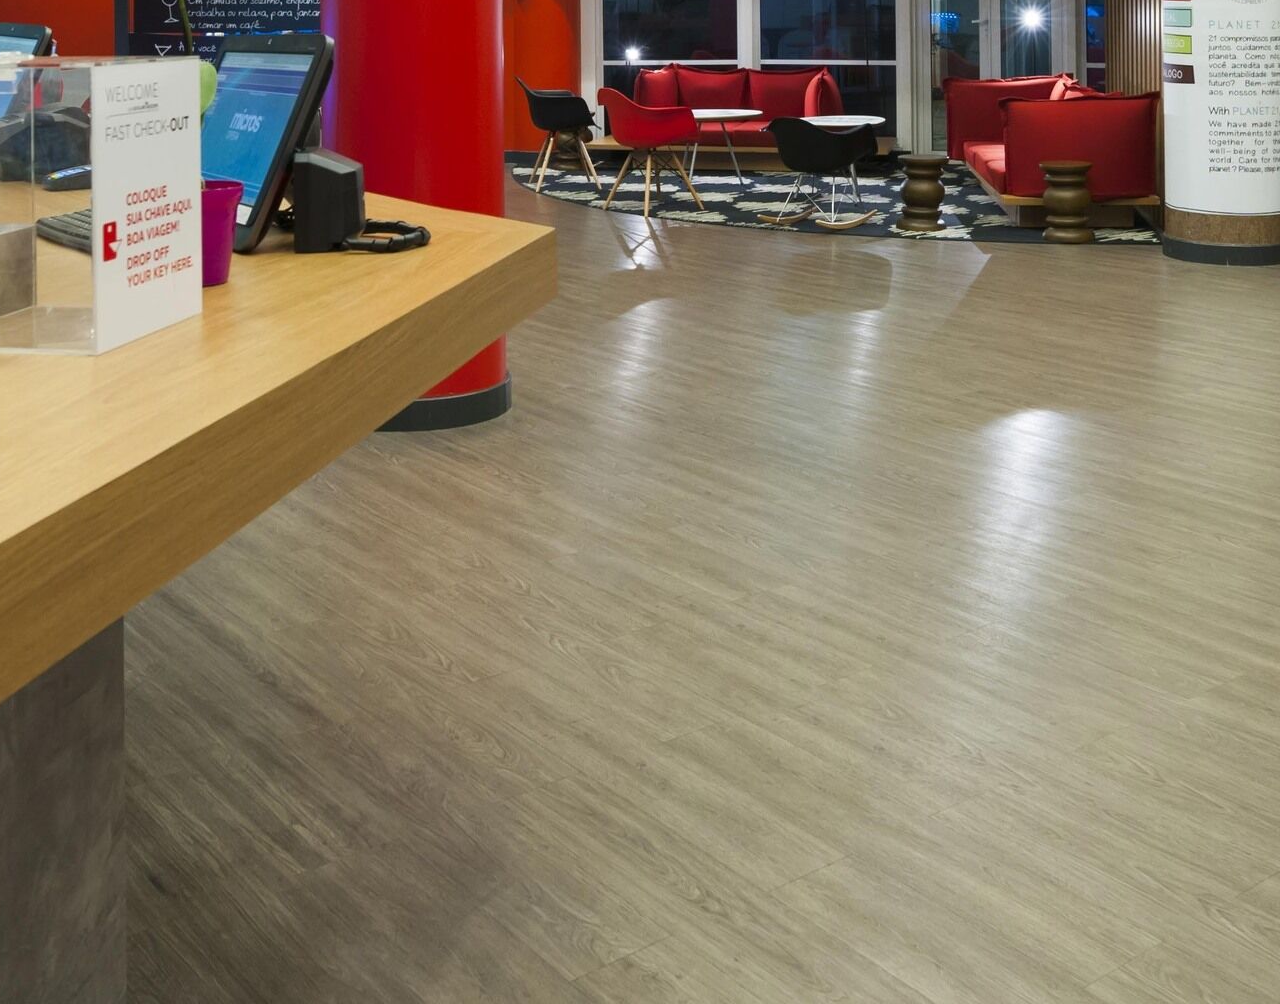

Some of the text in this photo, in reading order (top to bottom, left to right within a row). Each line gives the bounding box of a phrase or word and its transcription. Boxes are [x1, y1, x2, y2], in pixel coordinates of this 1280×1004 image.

[1208, 20, 1261, 30] PLANET
[1208, 34, 1217, 42] 21
[105, 82, 159, 103] WELCOME
[1232, 107, 1269, 115] PLANET
[1251, 120, 1272, 128] made
[105, 124, 131, 143] FAST
[1208, 138, 1243, 147] together
[126, 184, 168, 206] COLOQUE
[126, 211, 143, 226] SUA
[144, 203, 171, 221] CHAVE
[126, 231, 144, 246] BOA
[126, 245, 170, 270] DROP OFF
[126, 269, 152, 288] YOUR
[153, 263, 169, 280] KEY
